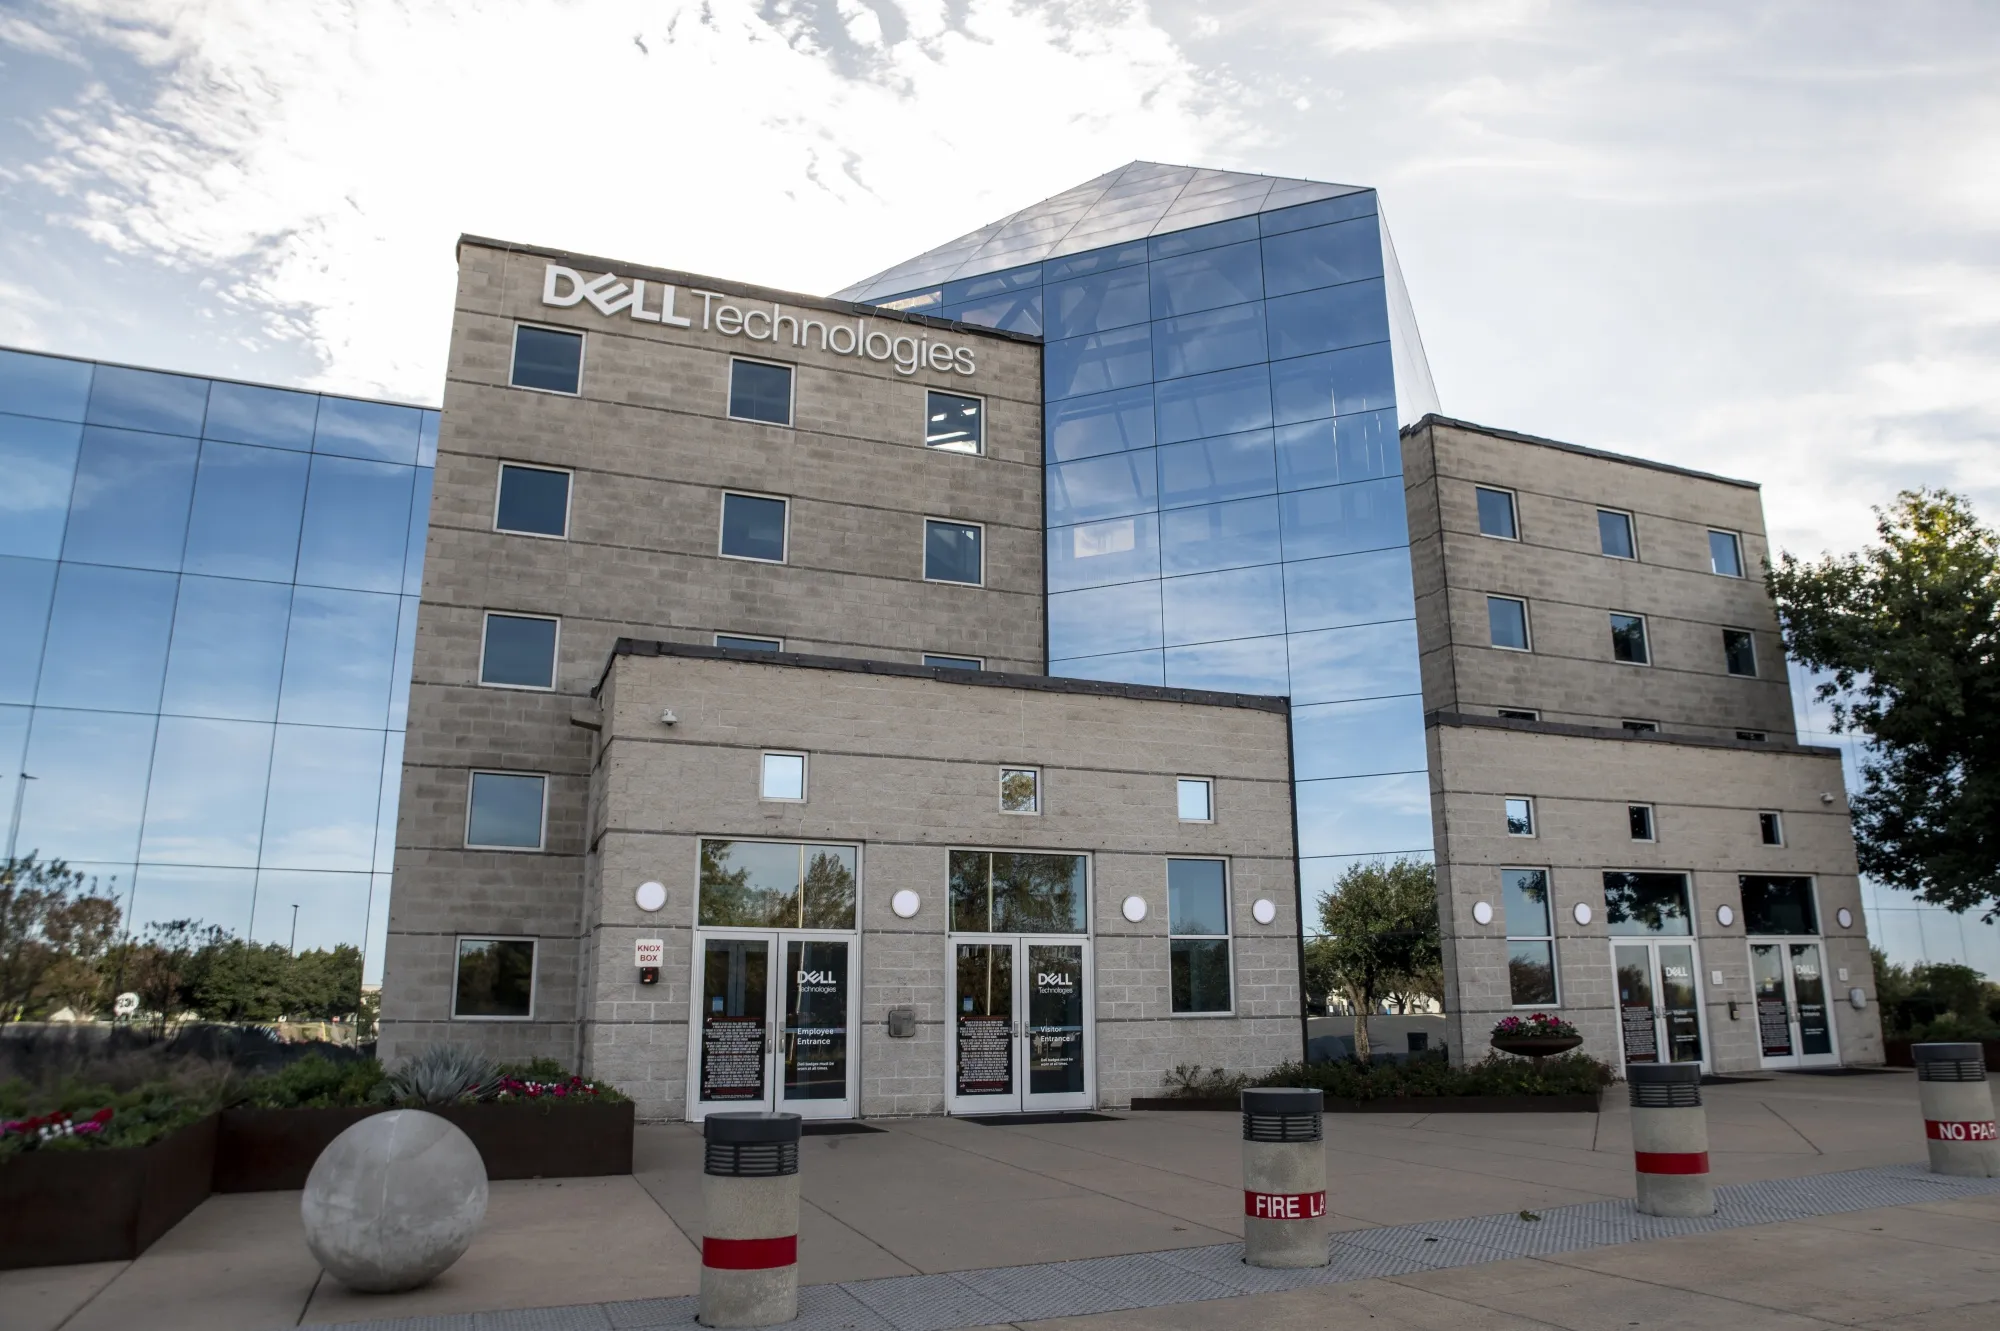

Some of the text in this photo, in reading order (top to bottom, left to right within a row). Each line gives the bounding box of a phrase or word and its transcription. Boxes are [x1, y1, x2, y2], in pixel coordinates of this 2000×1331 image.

[542, 264, 976, 376] DELL Technologies
[640, 954, 658, 962] BOX
[797, 970, 837, 984] DELL
[1665, 966, 1688, 977] DELL
[1038, 972, 1073, 985] DELL
[797, 985, 837, 994] Technologies
[1038, 986, 1073, 994] Technologies
[797, 1027, 834, 1036] Employee
[797, 1037, 831, 1045] Entrance
[1938, 1122, 1966, 1140] NO
[1256, 1195, 1300, 1218] FIRE
